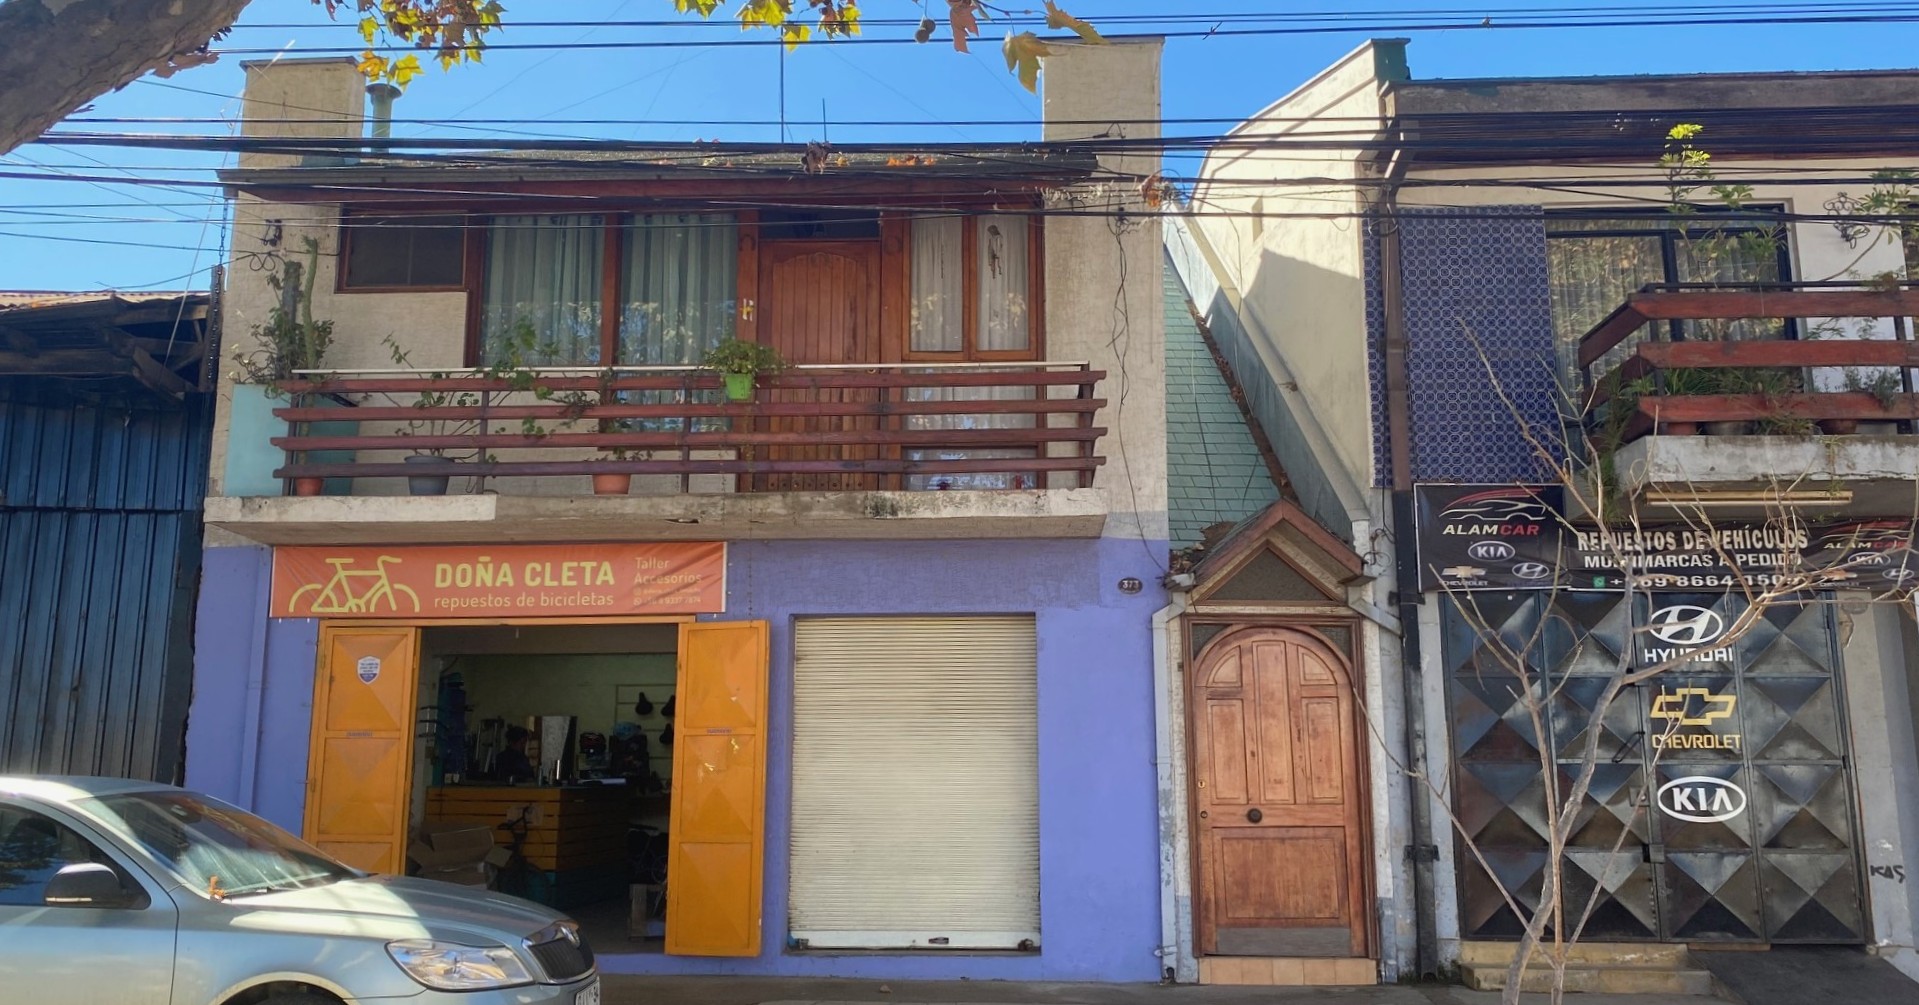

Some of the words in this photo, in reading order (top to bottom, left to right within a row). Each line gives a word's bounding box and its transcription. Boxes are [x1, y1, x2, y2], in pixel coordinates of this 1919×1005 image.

[1442, 524, 1540, 536] ALAMCAR
[1577, 530, 1677, 551] REPUESTOS
[1682, 530, 1705, 550] DE
[1477, 546, 1508, 558] KIA
[635, 557, 670, 569] Taller
[1584, 554, 1713, 568] MUIMARCAS
[435, 556, 514, 588] DOÑA
[524, 561, 616, 587] CLETA
[634, 573, 702, 585] Accesorios
[1676, 575, 1734, 587] 8664
[434, 594, 511, 610] repuestos
[516, 592, 535, 608] de
[540, 592, 614, 607] bicicletas
[1652, 734, 1742, 749] CHEVROLET
[1672, 787, 1735, 812] KIA
